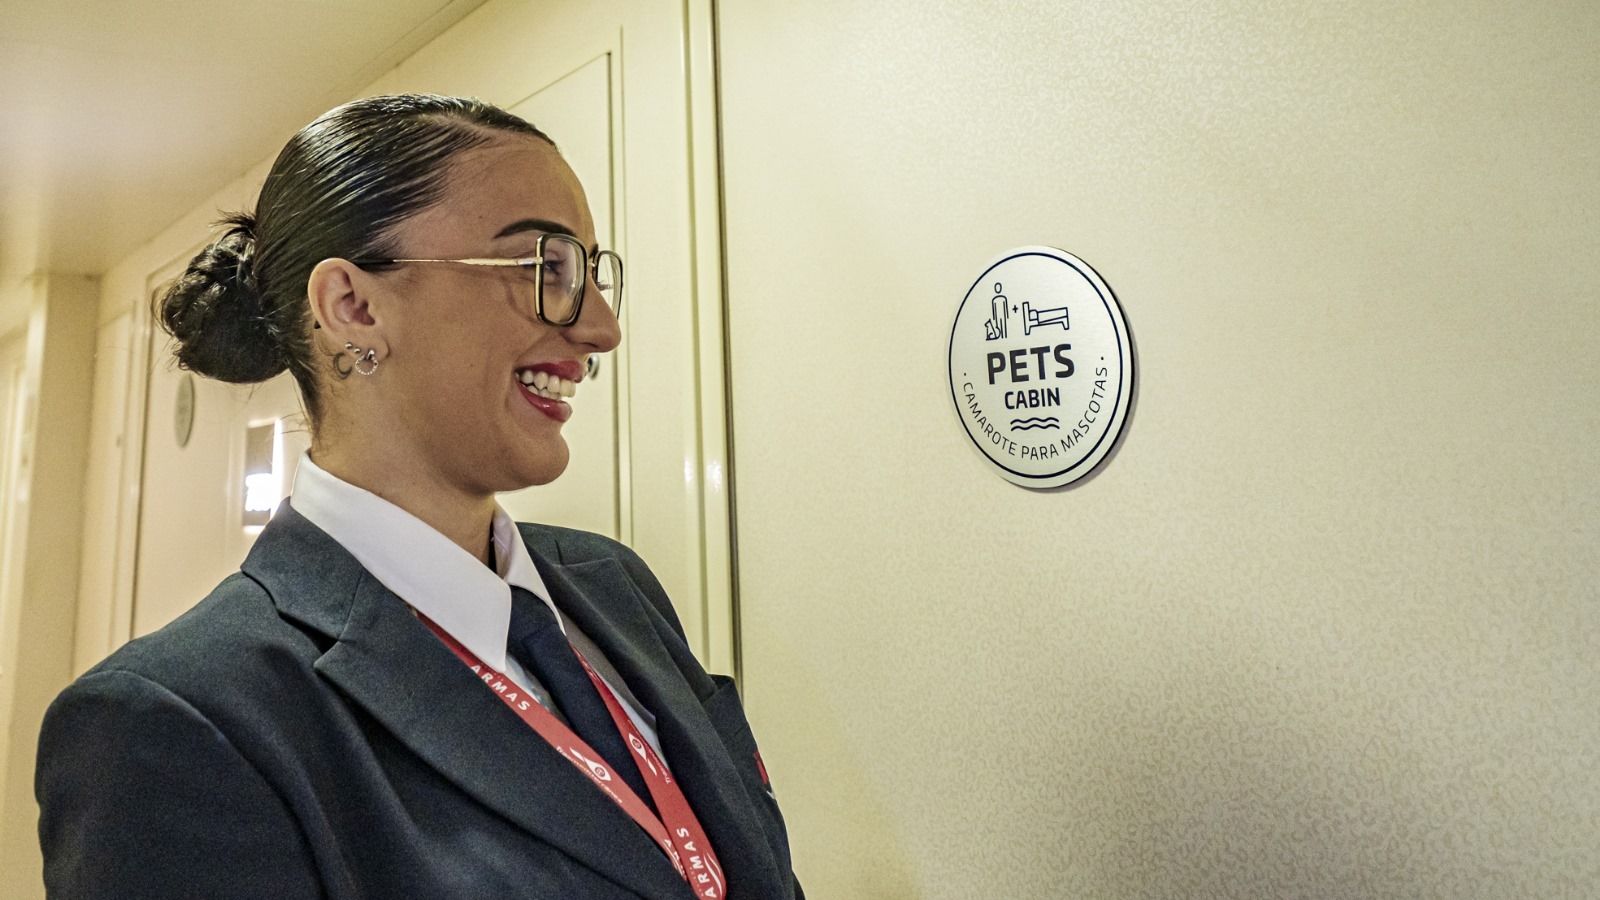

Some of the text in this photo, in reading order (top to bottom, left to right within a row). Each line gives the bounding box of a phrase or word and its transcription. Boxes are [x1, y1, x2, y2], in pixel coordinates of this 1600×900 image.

[987, 343, 1075, 385] PETS
[963, 366, 1108, 461] CAMAROTE PARA MASCOTAS
[1004, 387, 1061, 410] CABIN
[470, 664, 531, 711] ARMAS
[676, 827, 718, 899] ARMAS
